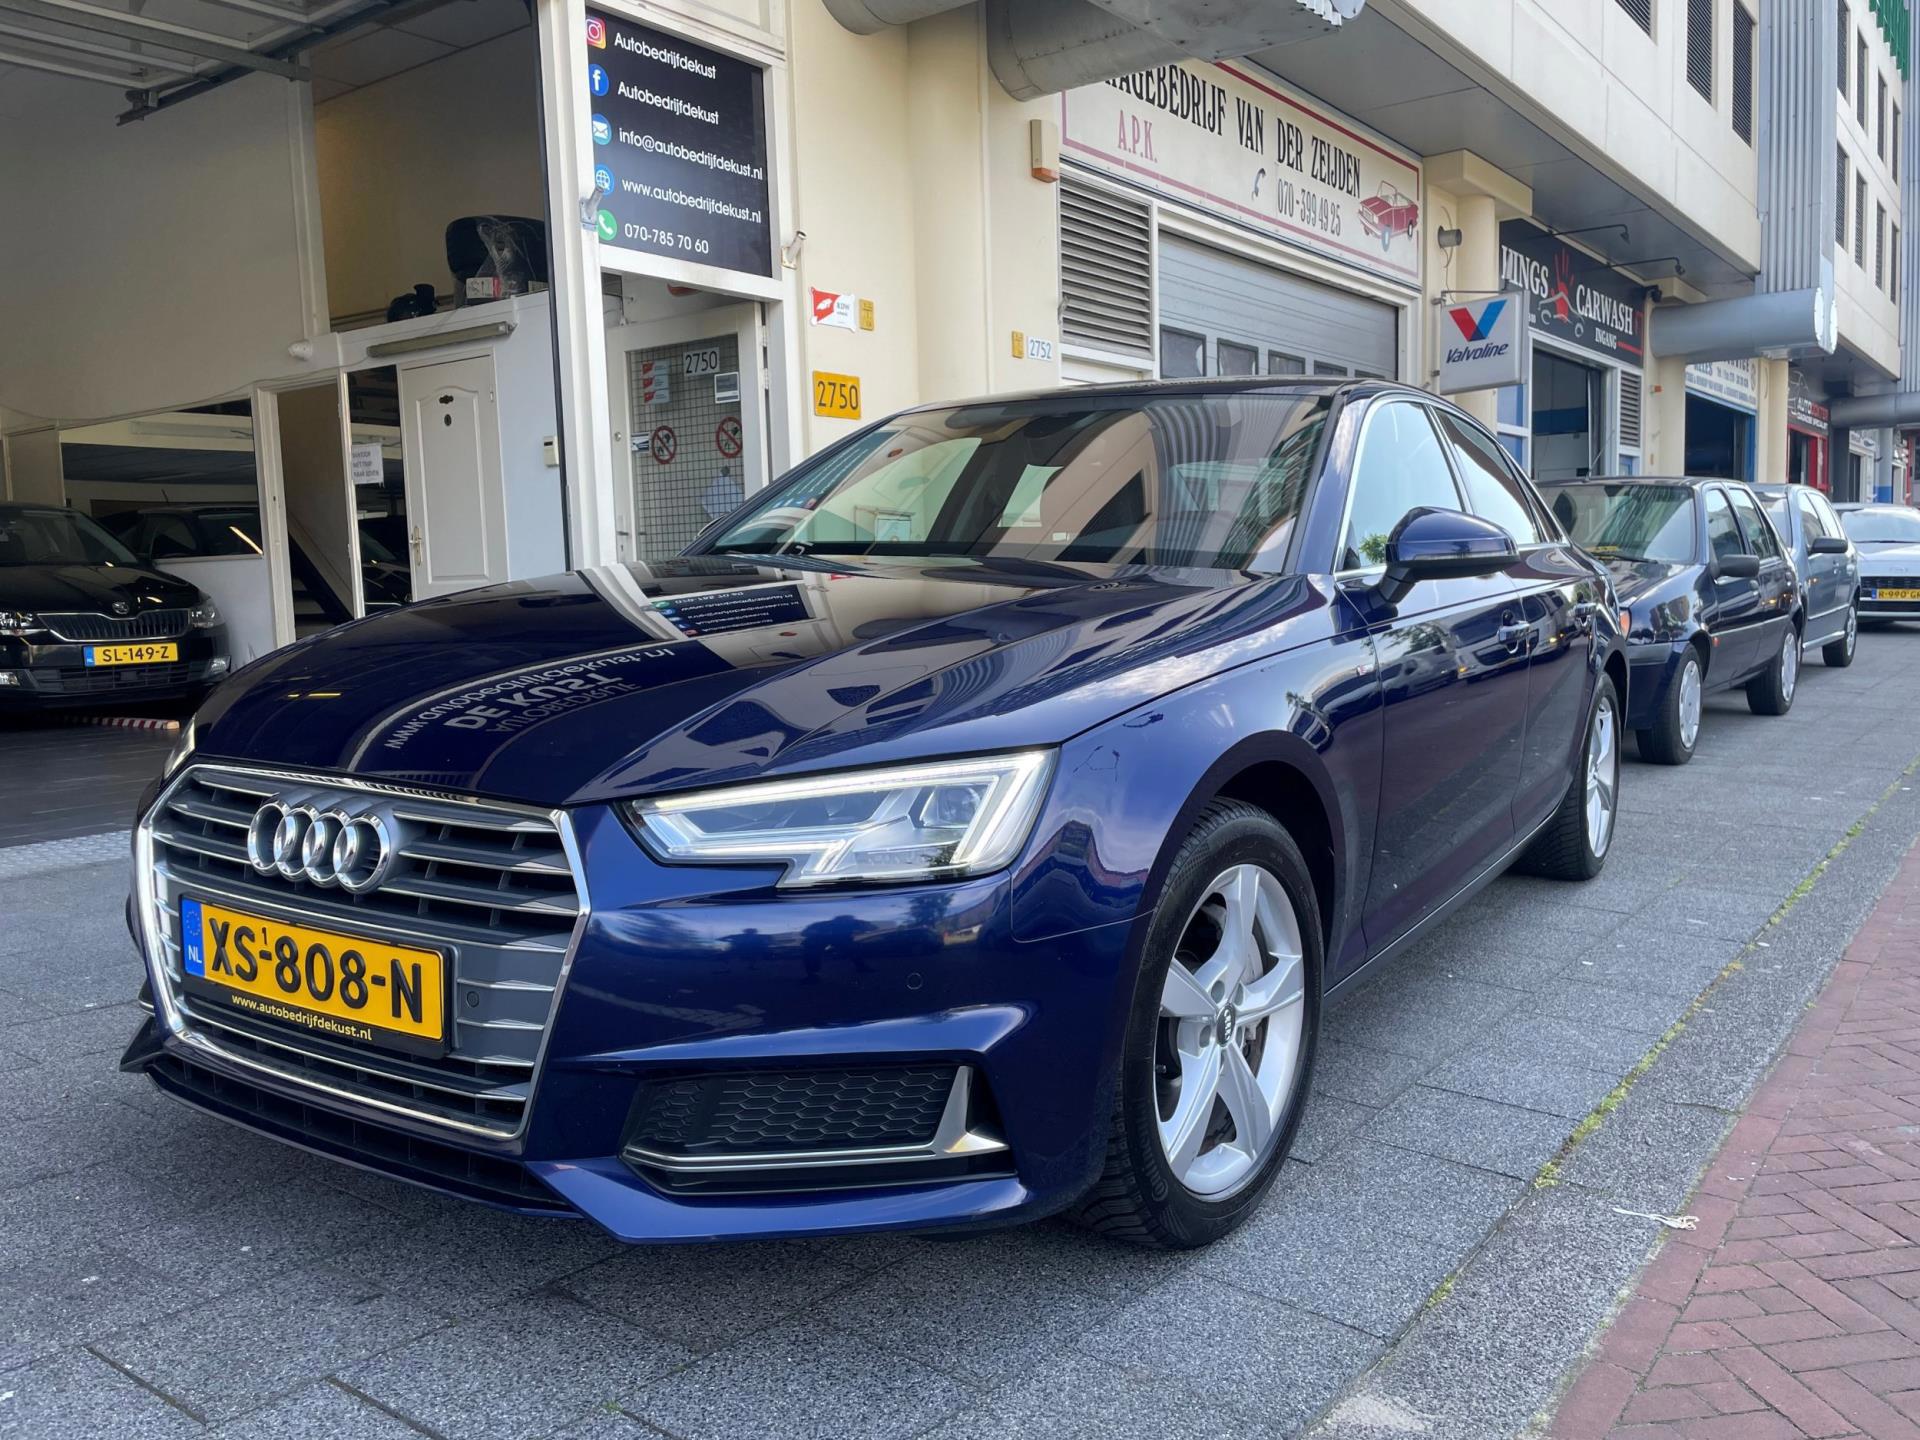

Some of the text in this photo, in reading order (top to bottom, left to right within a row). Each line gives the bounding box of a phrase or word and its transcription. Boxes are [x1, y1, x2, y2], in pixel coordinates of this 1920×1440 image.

[614, 32, 717, 79] Autobedrijfdekust
[618, 81, 720, 125] Autobedrijfdekust
[1105, 64, 1361, 199] GEBEDRIJF VAN DER ZEIJDEN
[1117, 109, 1158, 163] A.P.K.
[619, 128, 763, 180] info@autobedrijfdekust.nl
[622, 179, 761, 223] www.autobedrijfdekust.nl
[1319, 196, 1329, 232] 49
[1330, 202, 1341, 237] 25
[624, 223, 709, 254] 070-785 70 60
[1576, 284, 1634, 336] CARWASH
[685, 350, 718, 374] 2750
[1030, 339, 1052, 359] 2752
[1446, 342, 1509, 364] Valvoline
[817, 380, 859, 410] 2750
[102, 645, 170, 662] SL-149-Z
[188, 944, 203, 963] NL
[208, 917, 423, 1023] XS-808-N
[231, 993, 373, 1041] www.autobedrijfdekust.nl
